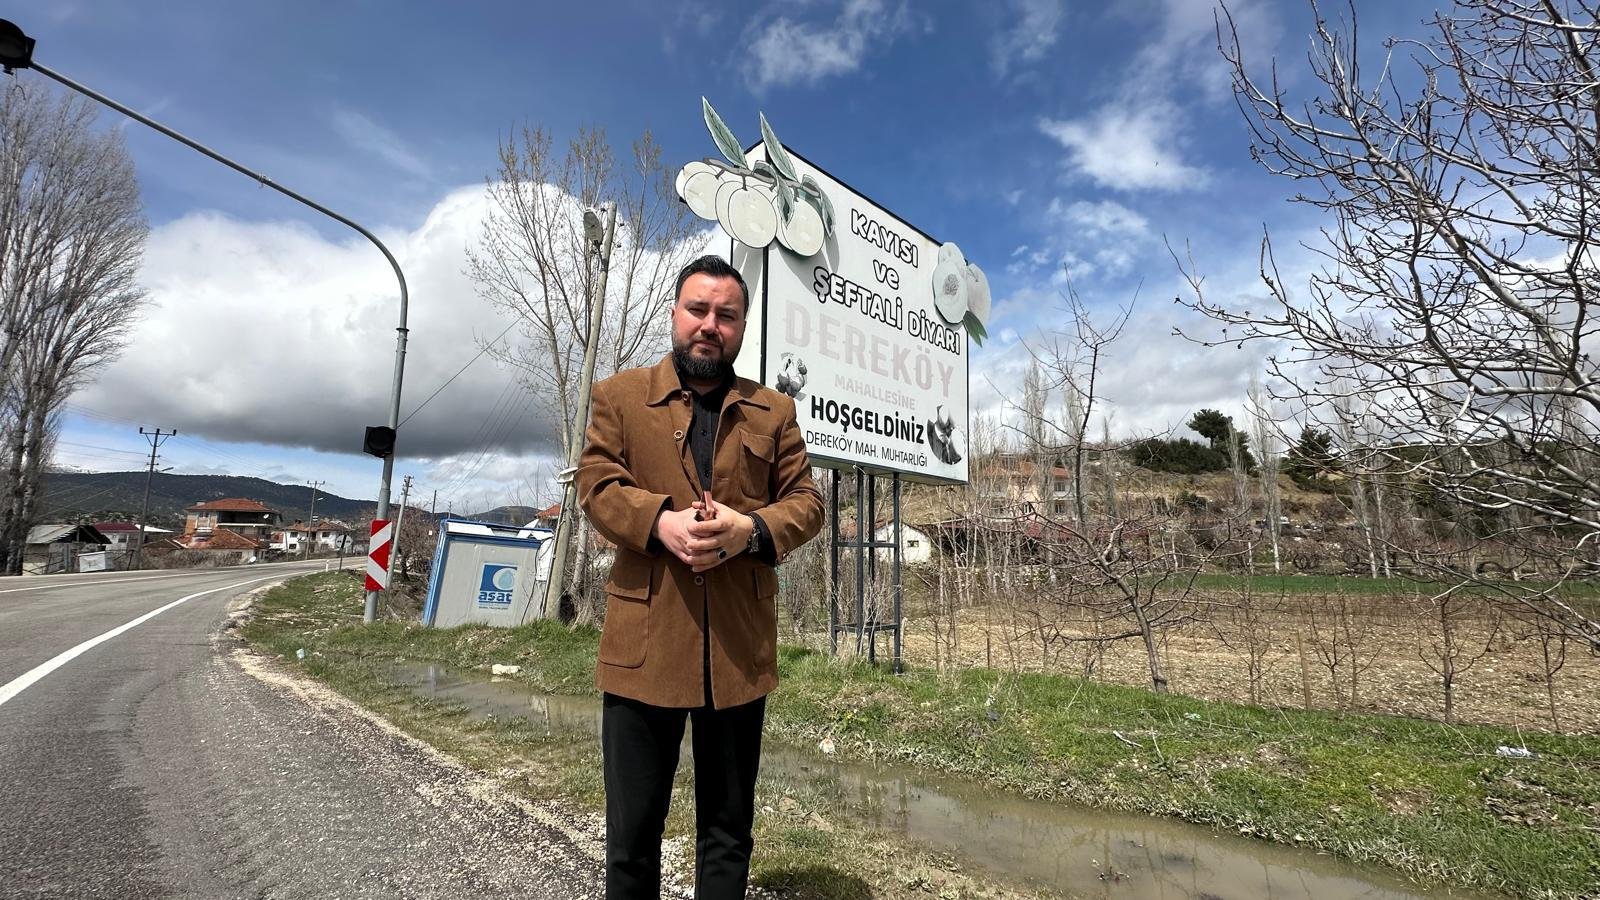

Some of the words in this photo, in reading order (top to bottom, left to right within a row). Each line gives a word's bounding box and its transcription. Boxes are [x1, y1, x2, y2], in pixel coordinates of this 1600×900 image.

[851, 208, 919, 268] KAYISI
[873, 259, 900, 290] ve
[813, 266, 903, 330] ŞEFTALİ
[908, 309, 961, 355] DİYARI
[784, 301, 954, 398] DEREKÖY
[834, 374, 916, 411] MAHALLESİNE
[811, 395, 925, 445] HOŞGELDİNİZ
[806, 430, 853, 452] DEREKÖY
[855, 440, 879, 458] MAH.
[881, 446, 928, 467] MUHTARLIĞI
[478, 591, 512, 602] asat
